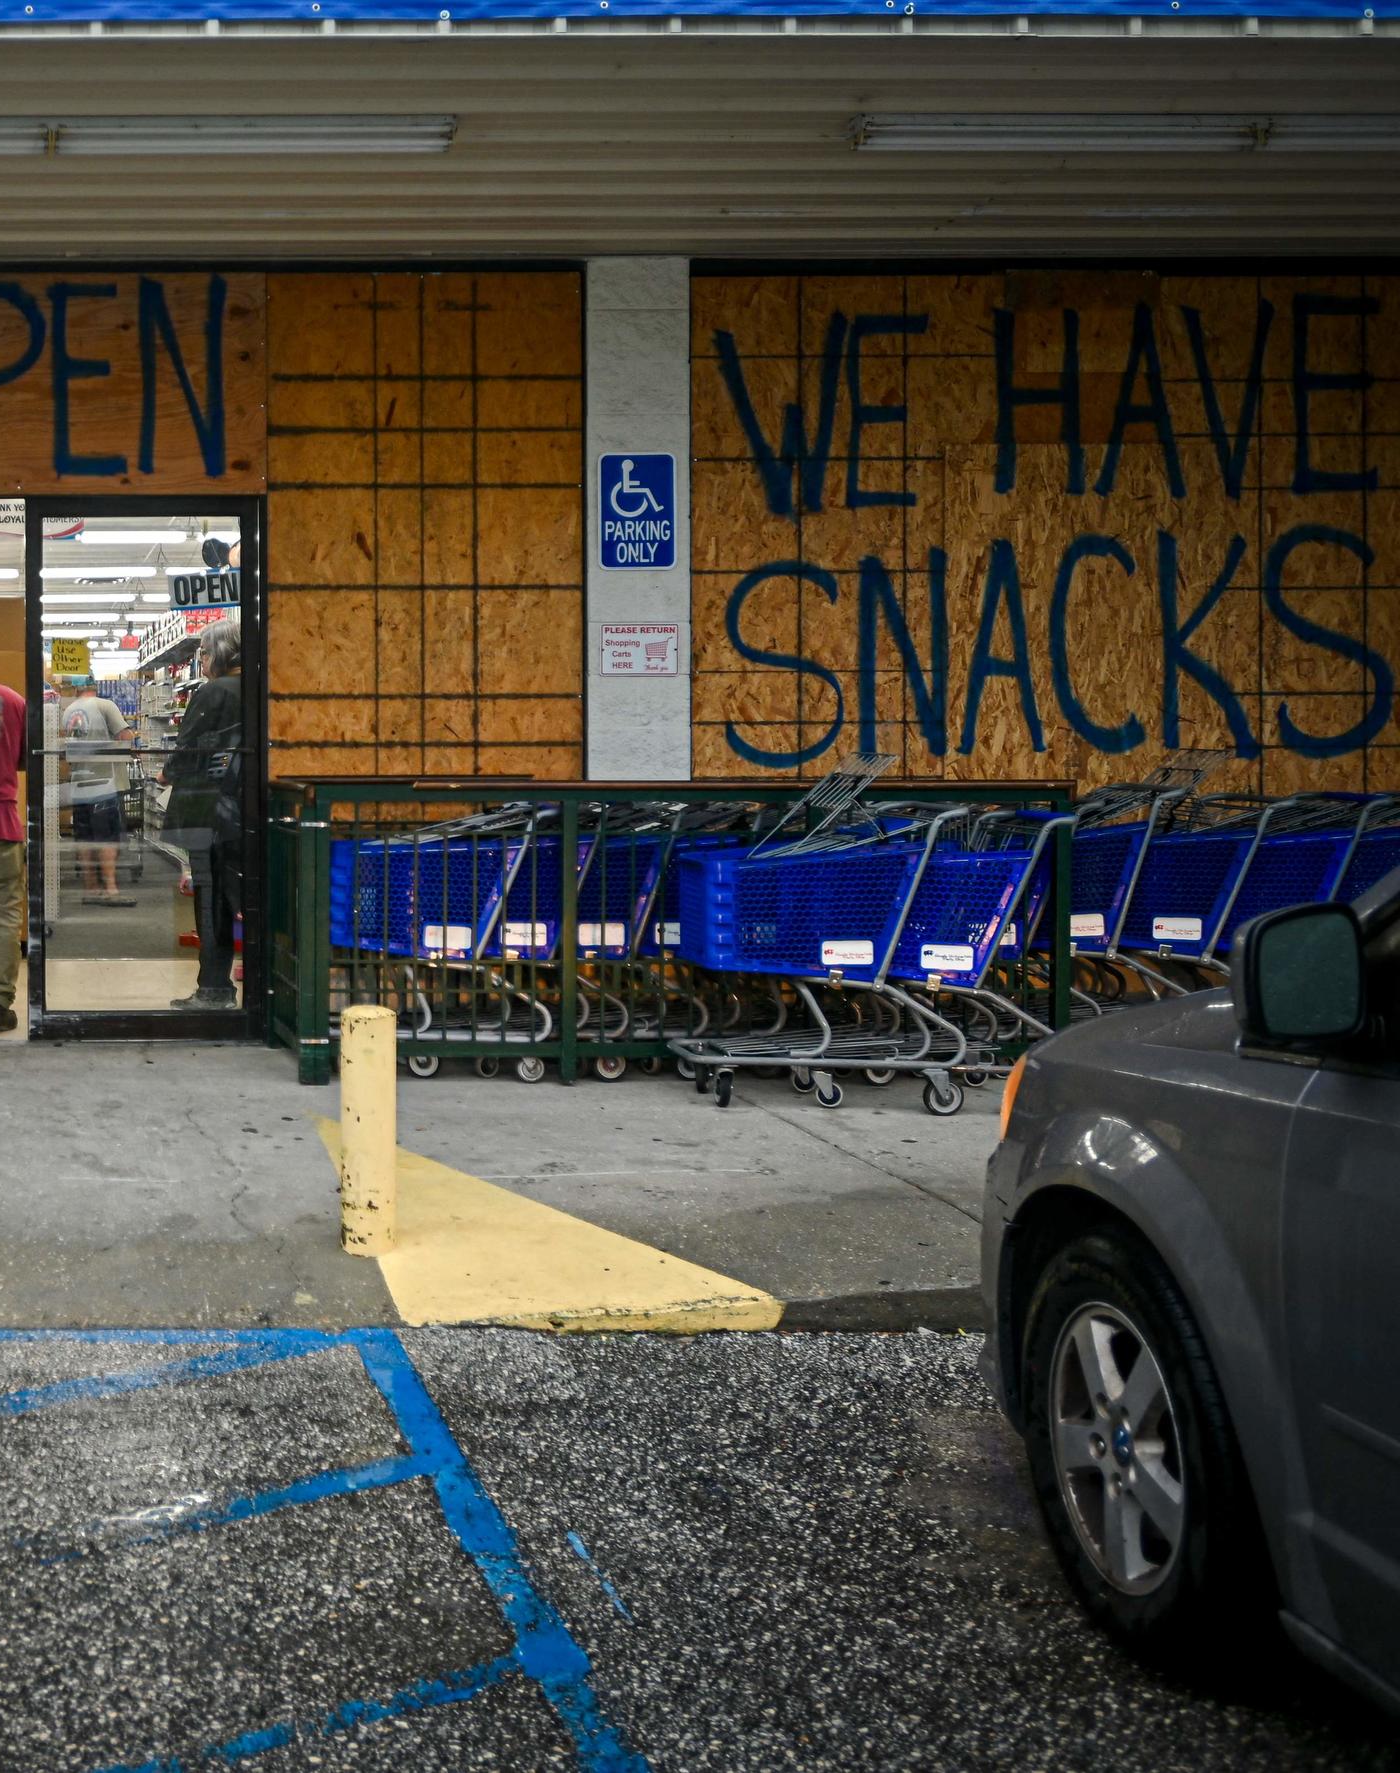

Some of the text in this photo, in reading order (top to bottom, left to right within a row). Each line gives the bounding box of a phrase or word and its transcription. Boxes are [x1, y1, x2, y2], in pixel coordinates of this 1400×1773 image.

[711, 292, 1382, 520] WE HAVE
[13, 503, 26, 512] YO
[604, 520, 671, 542] PARKING
[616, 541, 659, 564] ONLY
[173, 572, 239, 606] OPEN
[604, 626, 676, 634] PLEASE RETURN
[605, 639, 641, 648] Shopping
[723, 522, 1395, 769] SNACKS
[612, 650, 632, 658] Carts
[56, 663, 79, 671] Door
[612, 661, 633, 669] HERE
